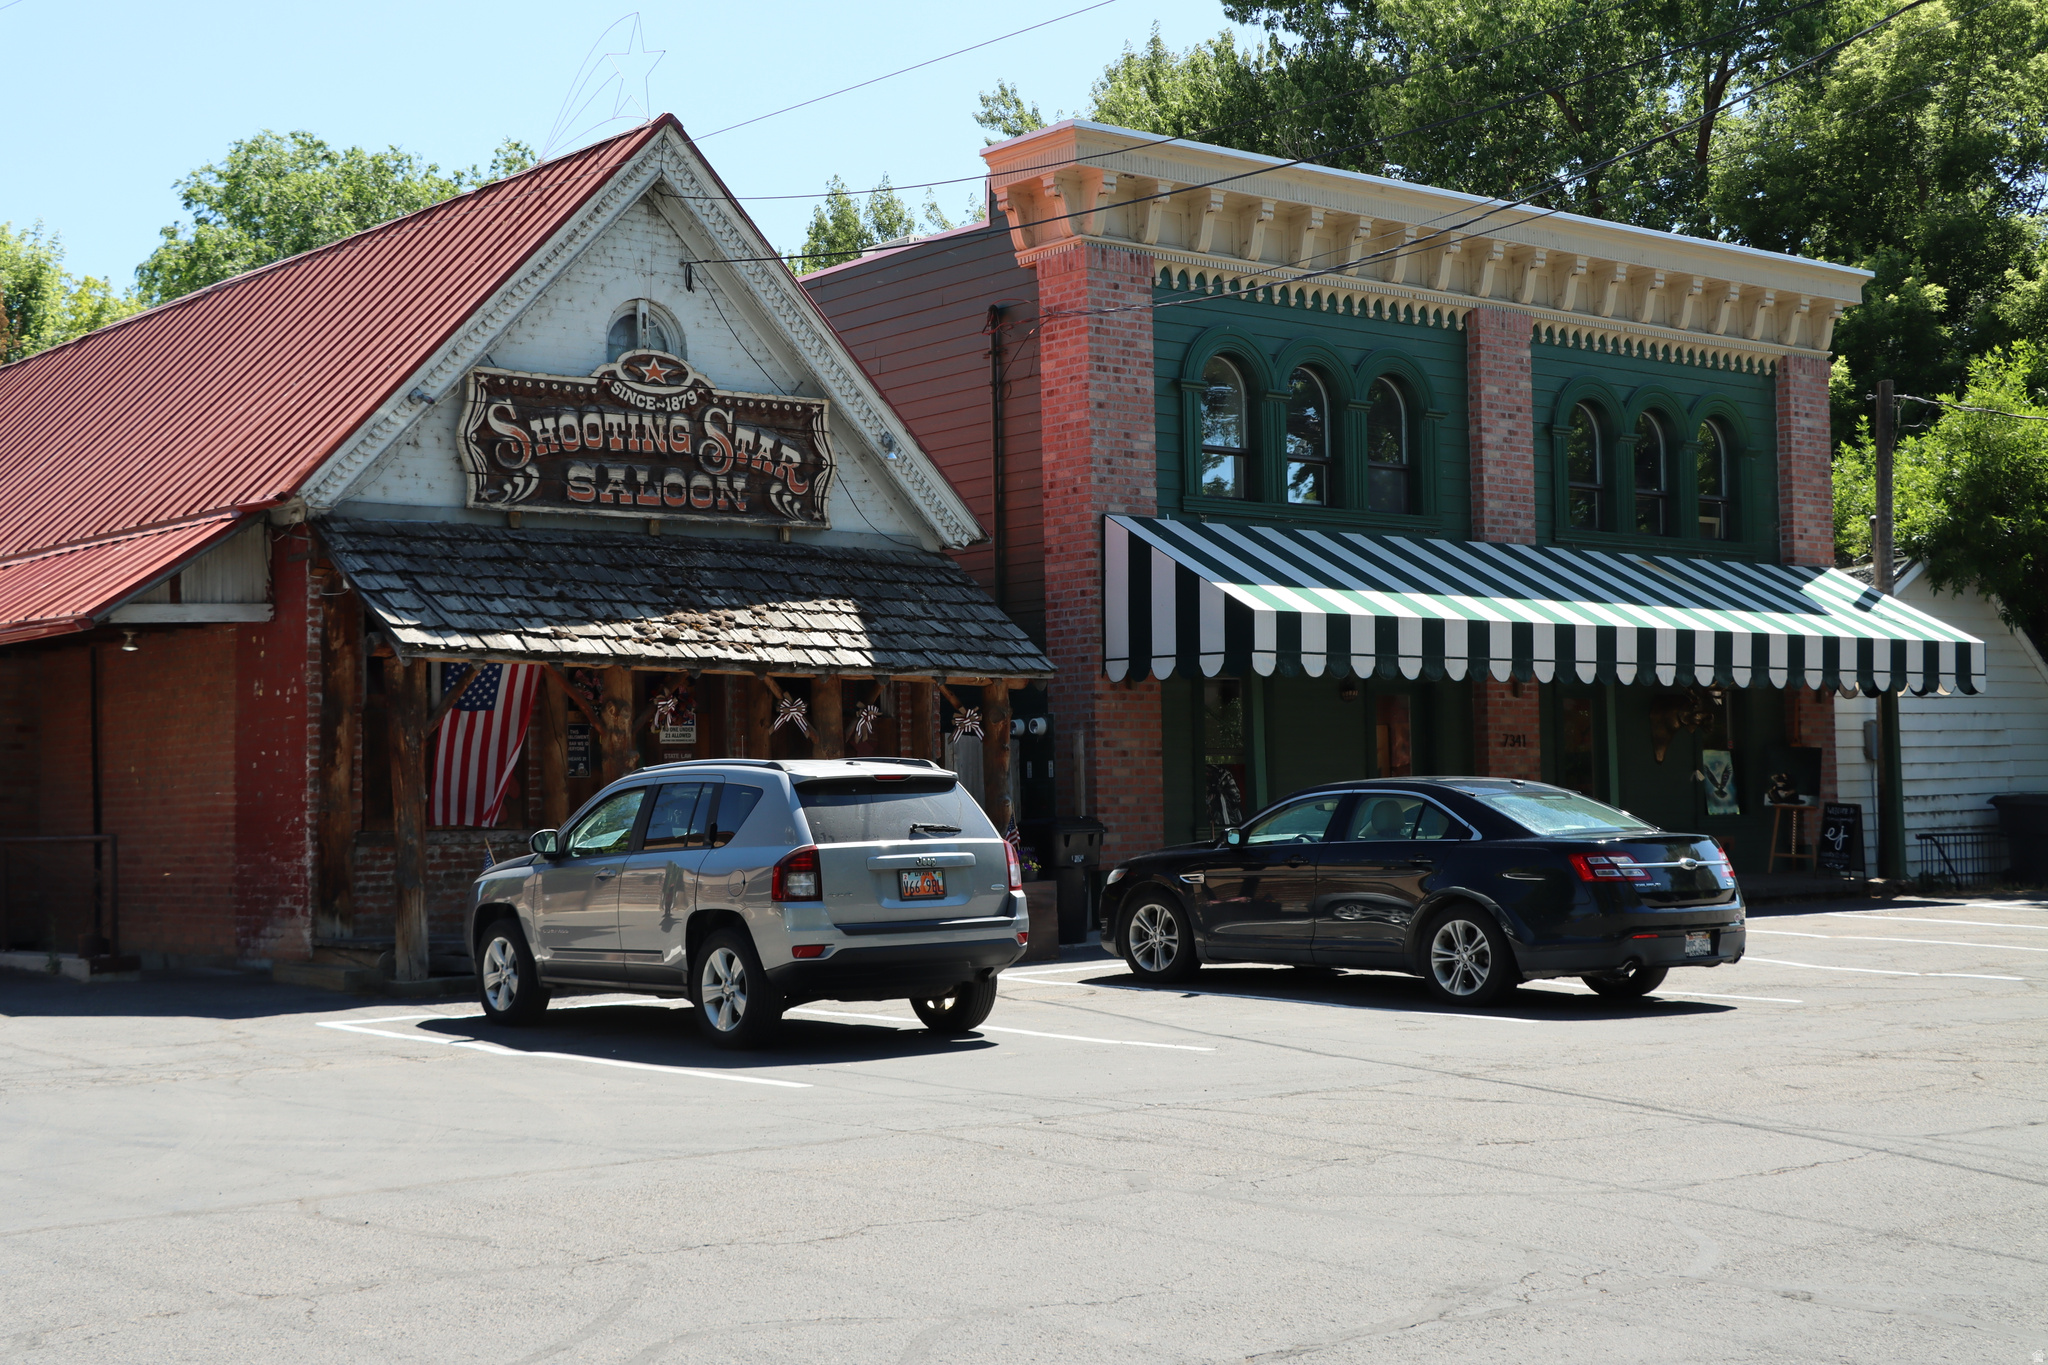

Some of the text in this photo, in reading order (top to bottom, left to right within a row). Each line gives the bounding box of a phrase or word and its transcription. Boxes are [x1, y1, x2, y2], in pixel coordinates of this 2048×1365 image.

[487, 398, 810, 495] SHOOTING STAR
[567, 465, 747, 512] SALOON
[1503, 734, 1526, 747] 7341
